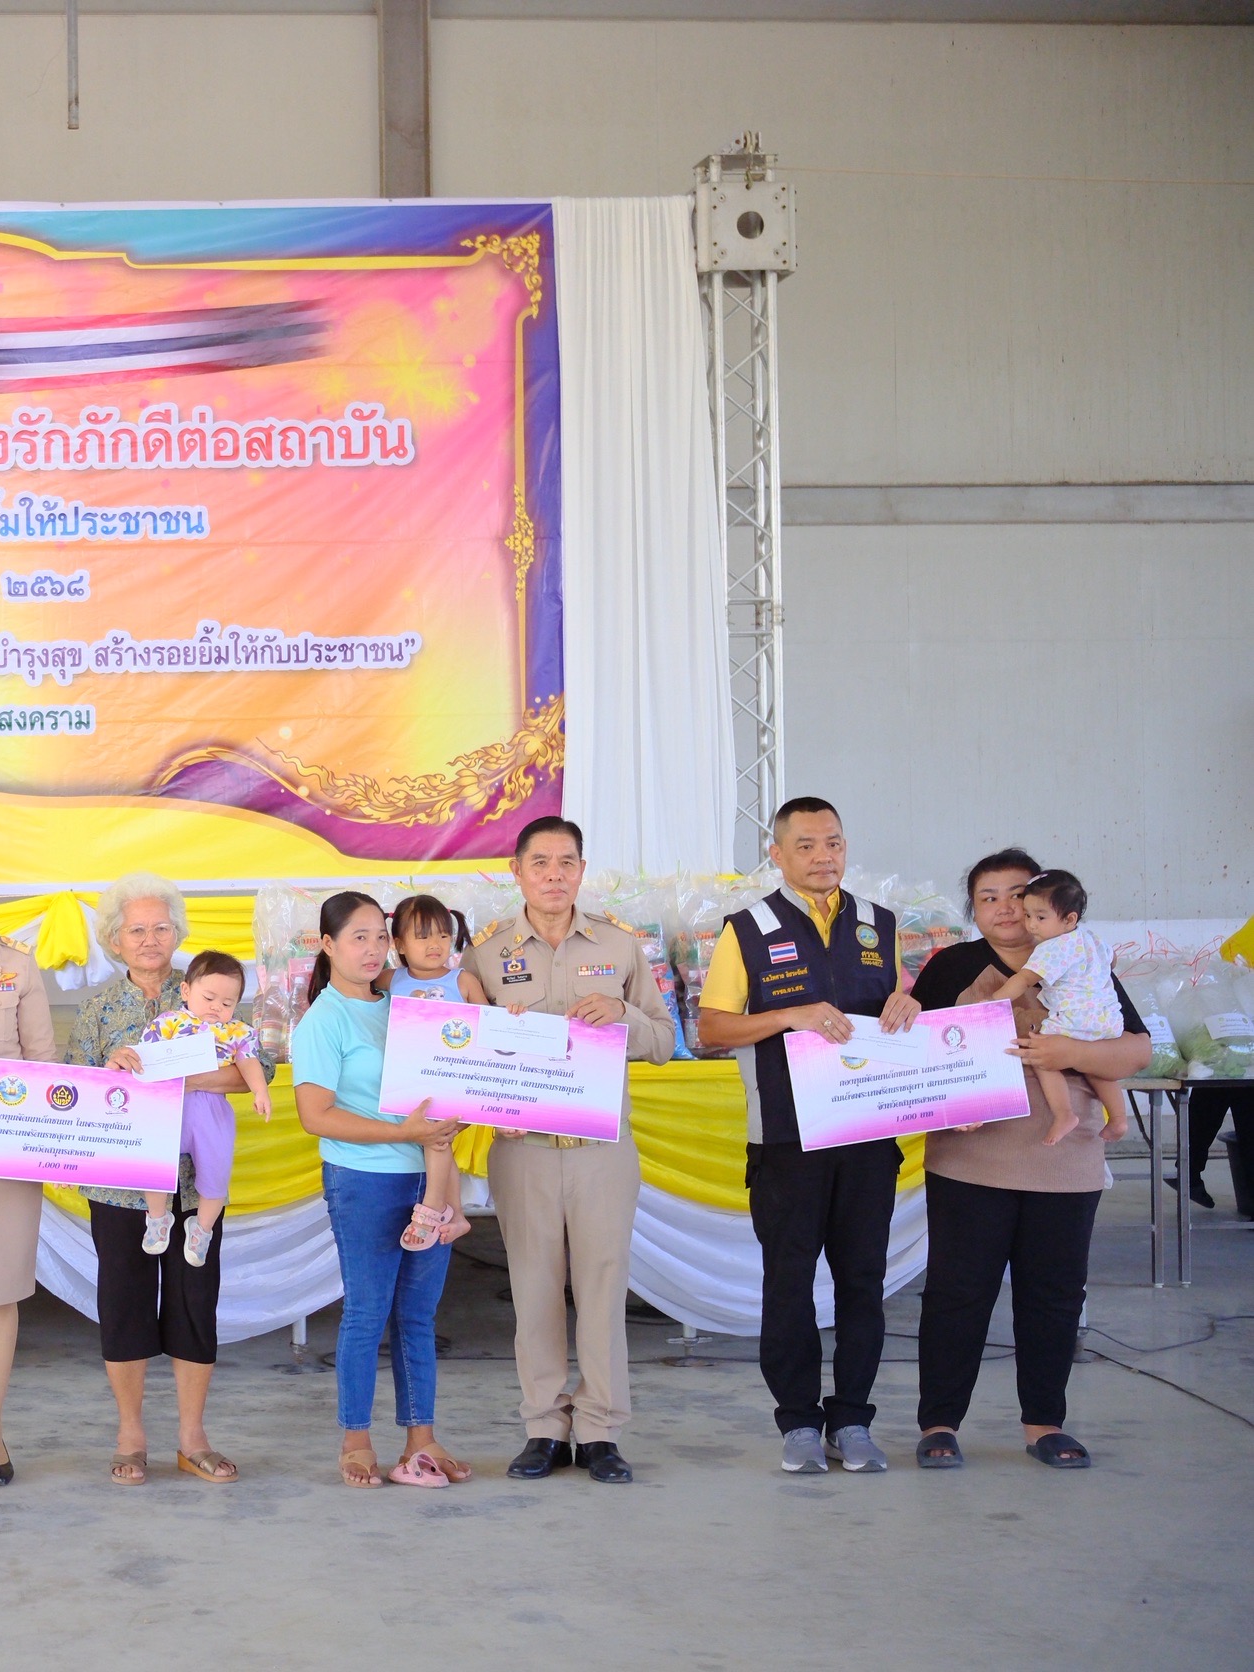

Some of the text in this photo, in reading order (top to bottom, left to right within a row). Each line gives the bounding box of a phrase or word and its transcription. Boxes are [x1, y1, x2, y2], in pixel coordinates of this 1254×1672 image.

[6, 573, 85, 598] ๒๕๖๘
[94, 625, 416, 669] สร้างรอยยิ้มให้กับประชาชน”
[480, 1104, 521, 1116] 1,000 บาท
[896, 1110, 934, 1123] 1,000 บาท
[37, 1161, 78, 1171] 1,000 บาท
